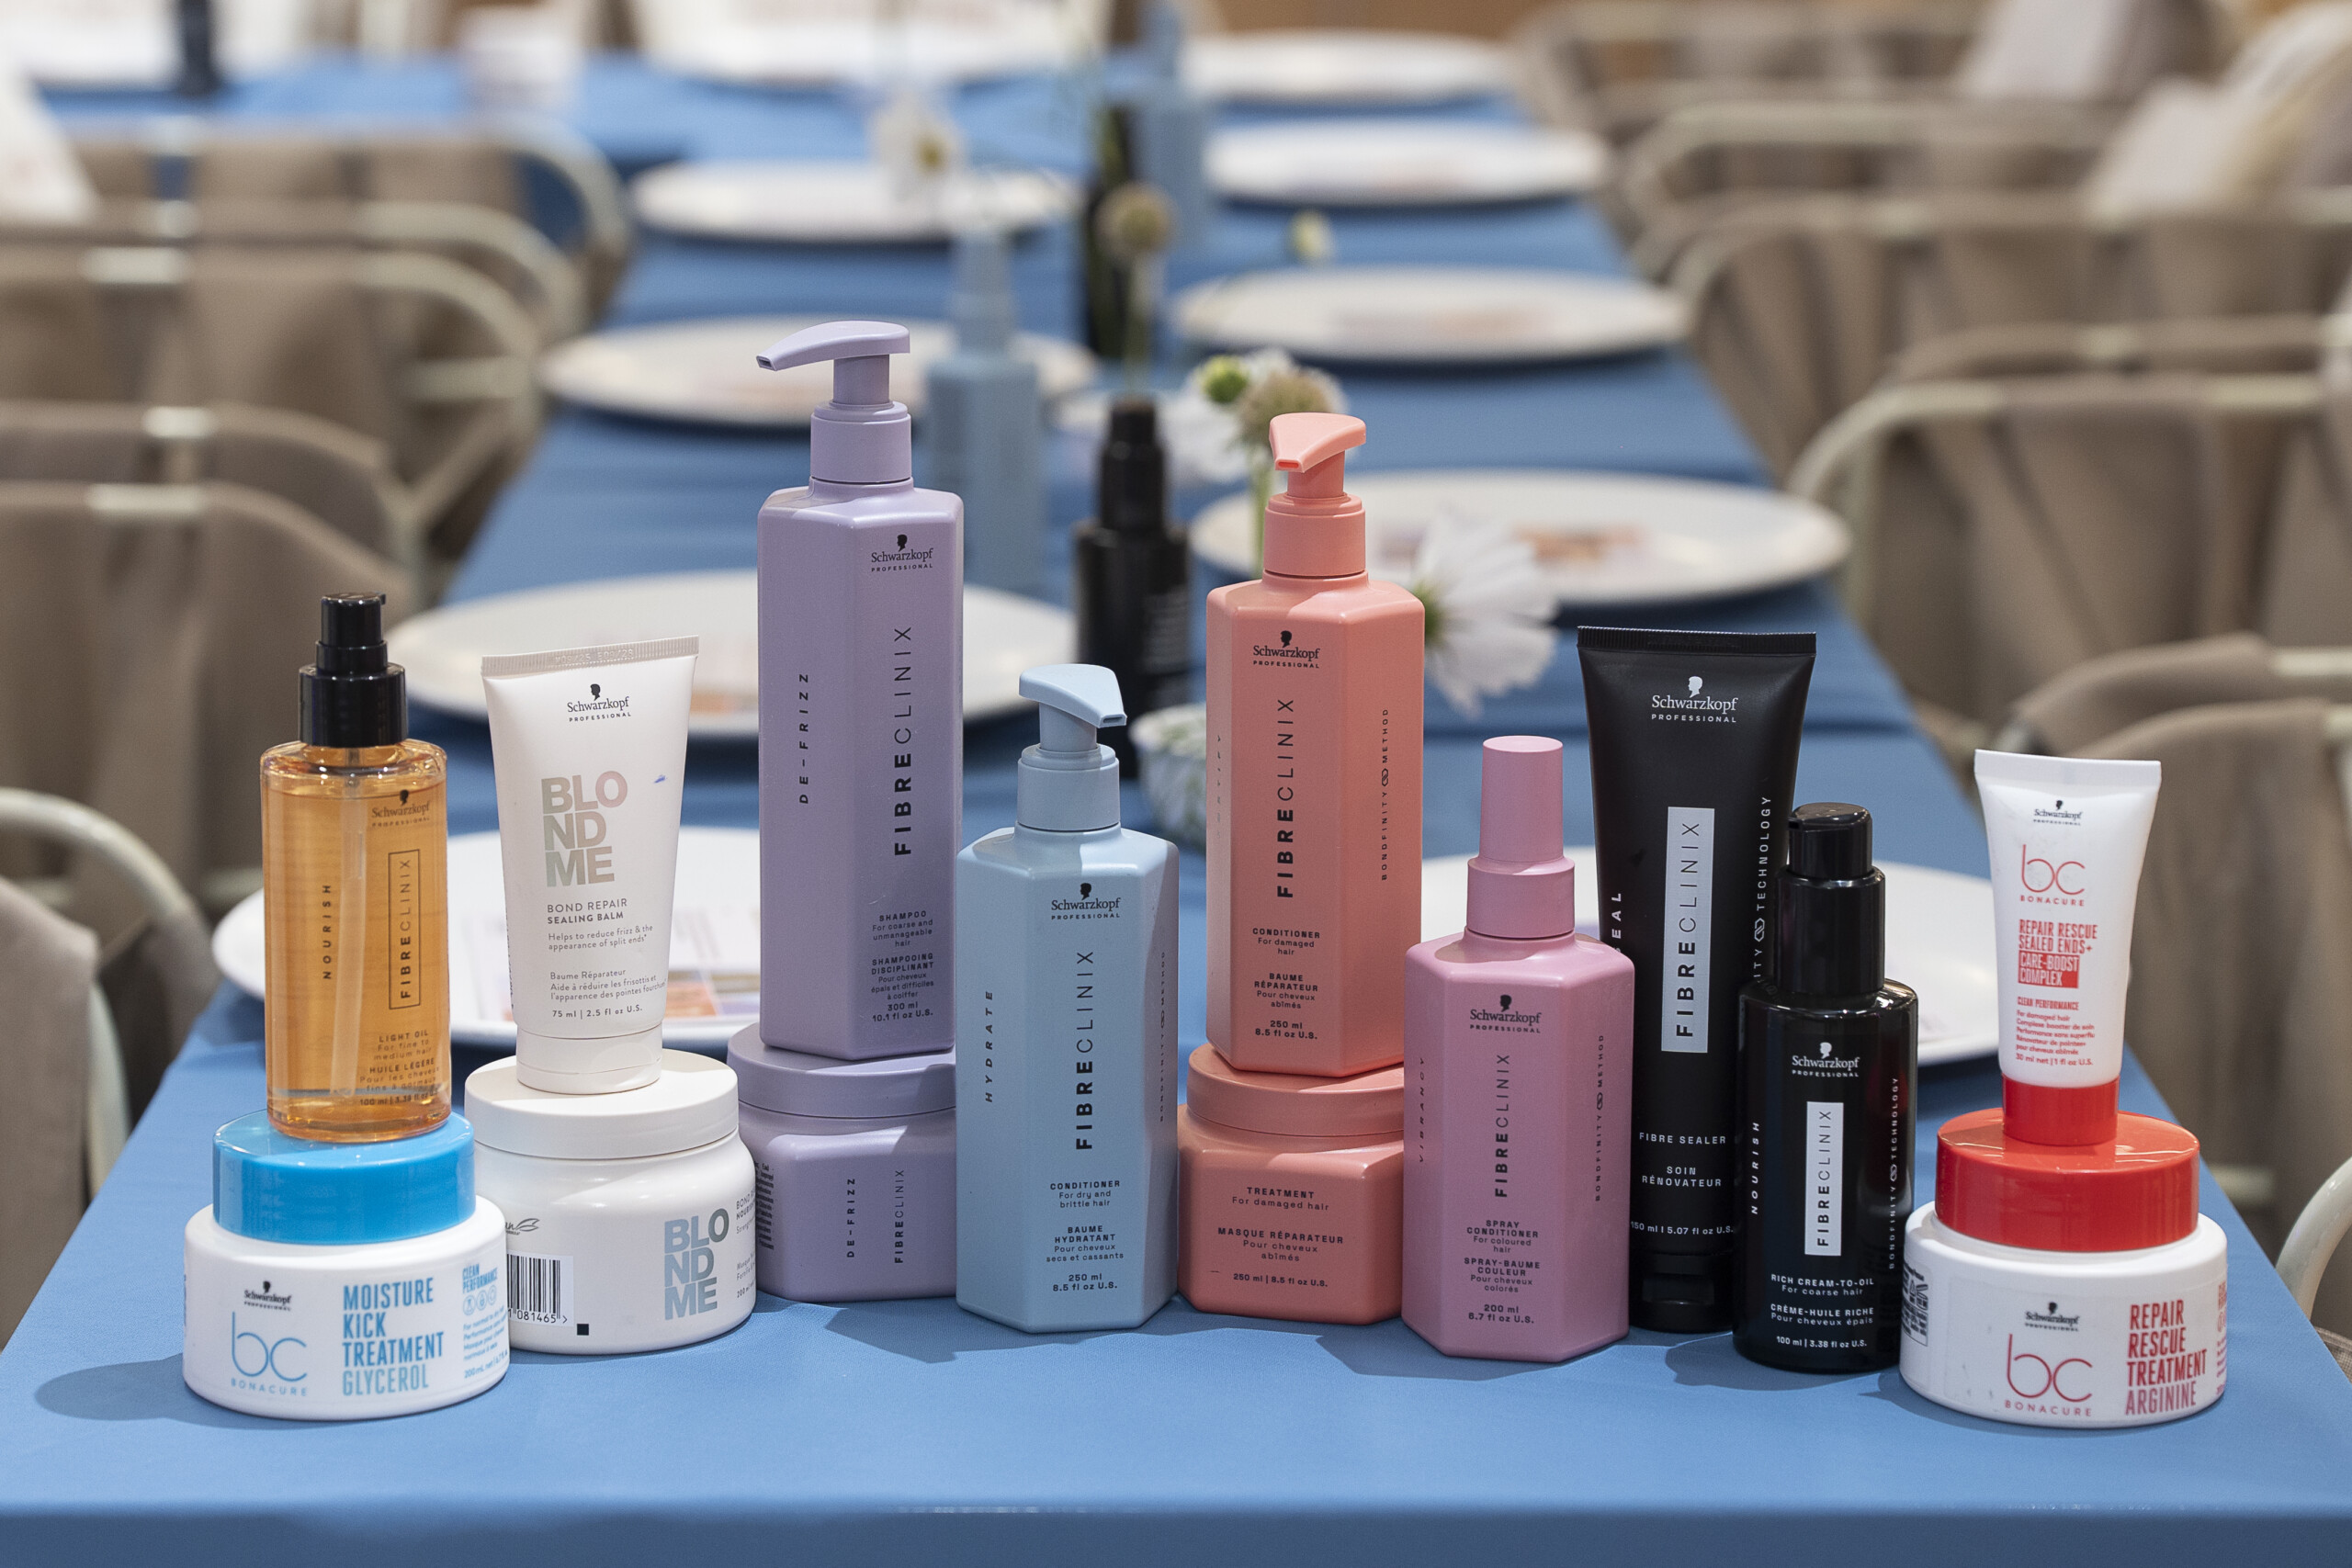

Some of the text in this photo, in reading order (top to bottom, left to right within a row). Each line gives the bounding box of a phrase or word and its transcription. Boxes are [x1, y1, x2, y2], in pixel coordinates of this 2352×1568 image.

[871, 547, 933, 563] Schwarzkopf
[871, 563, 933, 572] PROFESSIONAL
[1253, 645, 1320, 661] Schwarzkopf
[1253, 660, 1320, 669] PROFESSIONAL
[567, 695, 629, 713] Schwarzkopf
[1651, 694, 1739, 715] Schwarzkopf
[569, 712, 631, 722] PROFESSIONAL
[1651, 714, 1737, 724] PROFESSIONAL
[894, 626, 911, 856] FIBRECLINIX
[1277, 700, 1294, 898] FIBRECLINIX
[371, 801, 430, 818] Schwarzkopf
[1757, 796, 1771, 912] TECHNOLOGY
[546, 846, 615, 887] ME
[2021, 844, 2085, 895] bc
[547, 897, 628, 913] BOND REPAIR
[1051, 897, 1121, 912] Schwarzkopf
[2020, 895, 2085, 907] BONACURE
[548, 911, 624, 925] SEALING BALM
[879, 910, 927, 922] SHAMPOO
[918, 919, 933, 927] and
[322, 885, 331, 980] NOURISH
[400, 859, 412, 999] FIBRECLINIX
[548, 933, 573, 942] Helps
[587, 931, 615, 940] reduce
[616, 928, 633, 936] frizz
[642, 924, 653, 932] the
[873, 929, 933, 941] unmanageable
[1252, 928, 1320, 939] CONDITIONER
[1676, 823, 1700, 1037] FIBRECLINIX
[2019, 919, 2098, 939] REPAIR RESCUE
[548, 937, 627, 953] appearance of split
[1274, 939, 1315, 948] damaged
[2019, 934, 2053, 952] SEALED
[872, 953, 933, 965] SHAMPOOING
[550, 969, 626, 981] Baume Réparateur
[871, 962, 934, 975] DISCIPLINANT
[550, 977, 650, 991] Aide réduire les frisottis
[1269, 973, 1304, 982] BAUME
[2019, 967, 2063, 987] COMPLEX
[1254, 980, 1318, 992] RÉPARATEUR
[550, 987, 642, 1003] l'apparence des pointes
[1279, 992, 1316, 1001] cheveux
[586, 1009, 602, 1017] 2.5
[627, 1004, 643, 1014] U.S.
[888, 1003, 905, 1011] 300
[2035, 998, 2079, 1010] PERFORMANCE
[1270, 1021, 1288, 1029] 250
[1469, 1009, 1543, 1027] Schwarzkopf
[379, 1029, 428, 1043] LIGHT OIL
[1255, 1028, 1318, 1040] 8.5 U.S.
[1469, 1024, 1542, 1034] PROFESSIONAL
[985, 991, 993, 1103] HYDRATE
[1076, 952, 1093, 1150] FIBRECLINIX
[369, 1065, 400, 1075] HUILE
[1792, 1055, 1860, 1072] Schwarzkopf
[1792, 1069, 1859, 1077] PROFESSIONAL
[1495, 1055, 1510, 1198] FIBRECLINIX
[1639, 1133, 1725, 1145] FIBRE SEALER
[1667, 1166, 1696, 1176] SOIN
[1751, 1122, 1759, 1214] NOURISH
[1049, 1180, 1120, 1190] CONDITIONER
[1642, 1175, 1721, 1187] RÉNOVATEUR
[1816, 1111, 1832, 1247] FIBRECLINIX
[1077, 1191, 1091, 1200] dry
[1094, 1190, 1111, 1198] and
[1247, 1187, 1315, 1199] TREATMENT
[1060, 1201, 1090, 1209] brittle
[1232, 1196, 1329, 1211] For damaged hair
[895, 1170, 905, 1264] FIBRECLINIX
[1068, 1225, 1103, 1234] BAUME
[1486, 1220, 1520, 1229] SPRAY
[1667, 1226, 1689, 1235] 5.07
[1055, 1234, 1116, 1244] HYDRATANT
[1217, 1227, 1343, 1244] MASQUE RÉPARATEUR
[1466, 1227, 1539, 1238] CONDITIONER
[1242, 1239, 1318, 1253] Pour cheveux
[1491, 1237, 1532, 1247] coloured
[1082, 1252, 1124, 1260] cassants
[1464, 1258, 1542, 1269] SPRAY-BAUME
[1069, 1274, 1088, 1282] 250
[1233, 1273, 1250, 1281] 250
[1477, 1267, 1526, 1277] COULEUR
[1053, 1281, 1117, 1292] 8.5 U.S.
[1494, 1277, 1533, 1286] cheveux
[1771, 1274, 1874, 1289] RICH CREAM-TO-OIL
[244, 1290, 292, 1306] Schwarzkopf
[344, 1277, 434, 1311] MOISTURE
[664, 1277, 718, 1321] ME
[1802, 1288, 1863, 1296] coarse hair
[1484, 1304, 1504, 1313] 200
[1845, 1307, 1874, 1317] RICHE
[2130, 1299, 2185, 1330] REPAIR
[516, 1309, 557, 1325] 081465
[1514, 1315, 1535, 1325] U.S.
[1770, 1313, 1842, 1326] Pour cheveux
[344, 1312, 387, 1339] KICK
[232, 1312, 307, 1382] bc
[1777, 1336, 1828, 1348] 100 3.38
[2128, 1326, 2186, 1359] RESCUE
[342, 1331, 445, 1368] TREATMENT
[2007, 1334, 2092, 1402] bc
[2127, 1348, 2207, 1387] TREATMENT
[231, 1378, 307, 1396] BONACURE
[343, 1364, 430, 1396] GLYCEROL
[2125, 1381, 2197, 1416] ARGININE
[2005, 1399, 2092, 1416] BONACURE
